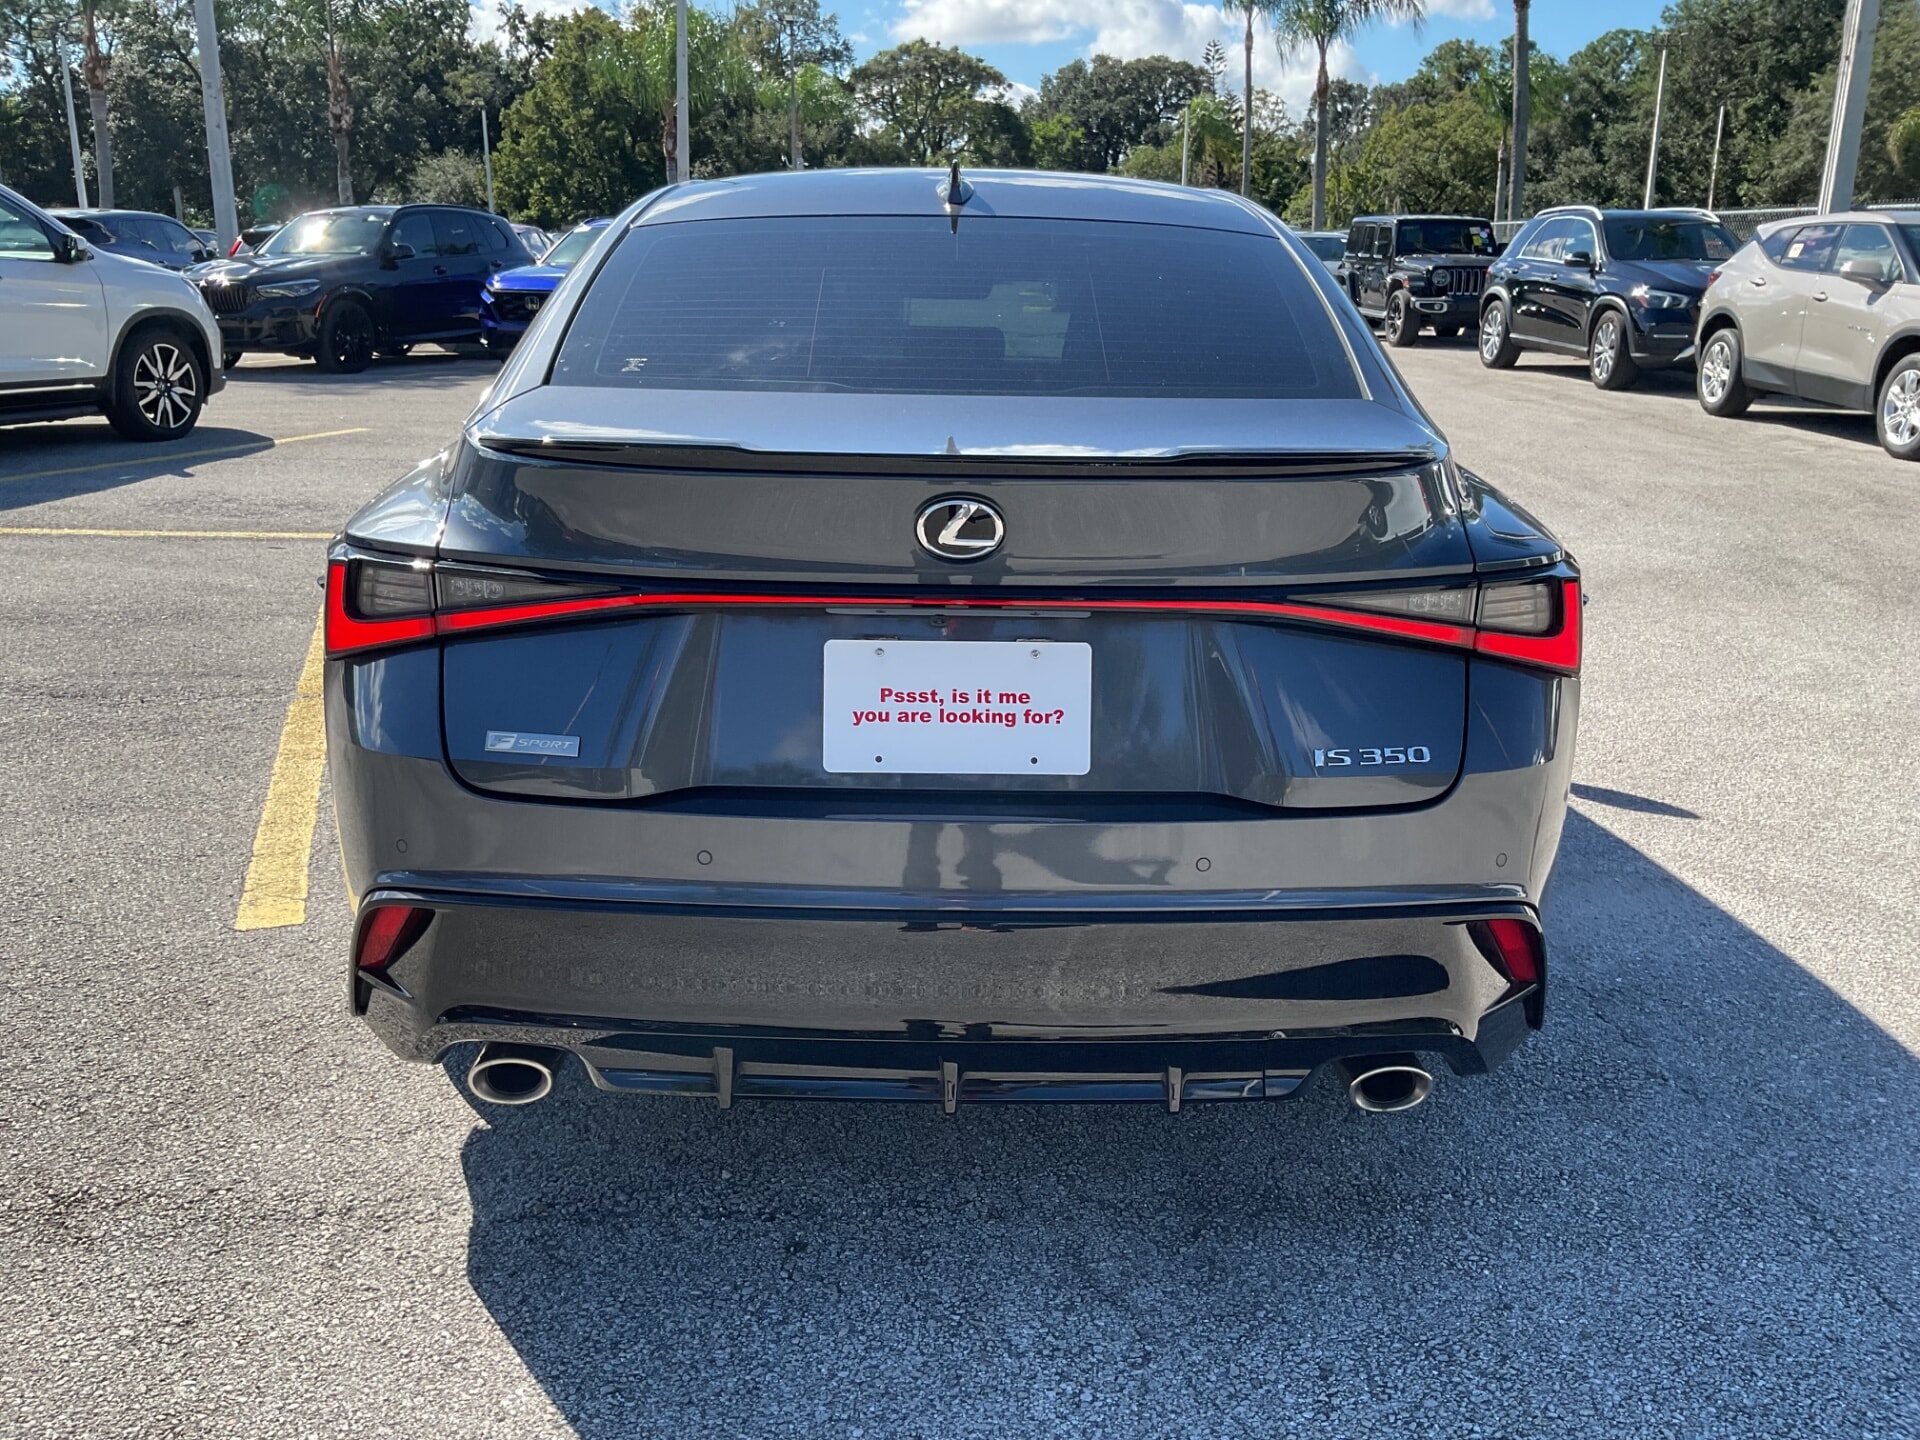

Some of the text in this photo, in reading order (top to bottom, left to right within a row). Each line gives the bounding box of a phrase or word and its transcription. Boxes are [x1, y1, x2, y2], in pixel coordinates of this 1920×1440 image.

[879, 687, 1031, 707] Pssst, is it me
[852, 708, 1065, 728] you are looking for?
[517, 738, 574, 750] SPORT
[1314, 746, 1431, 767] IS 350
